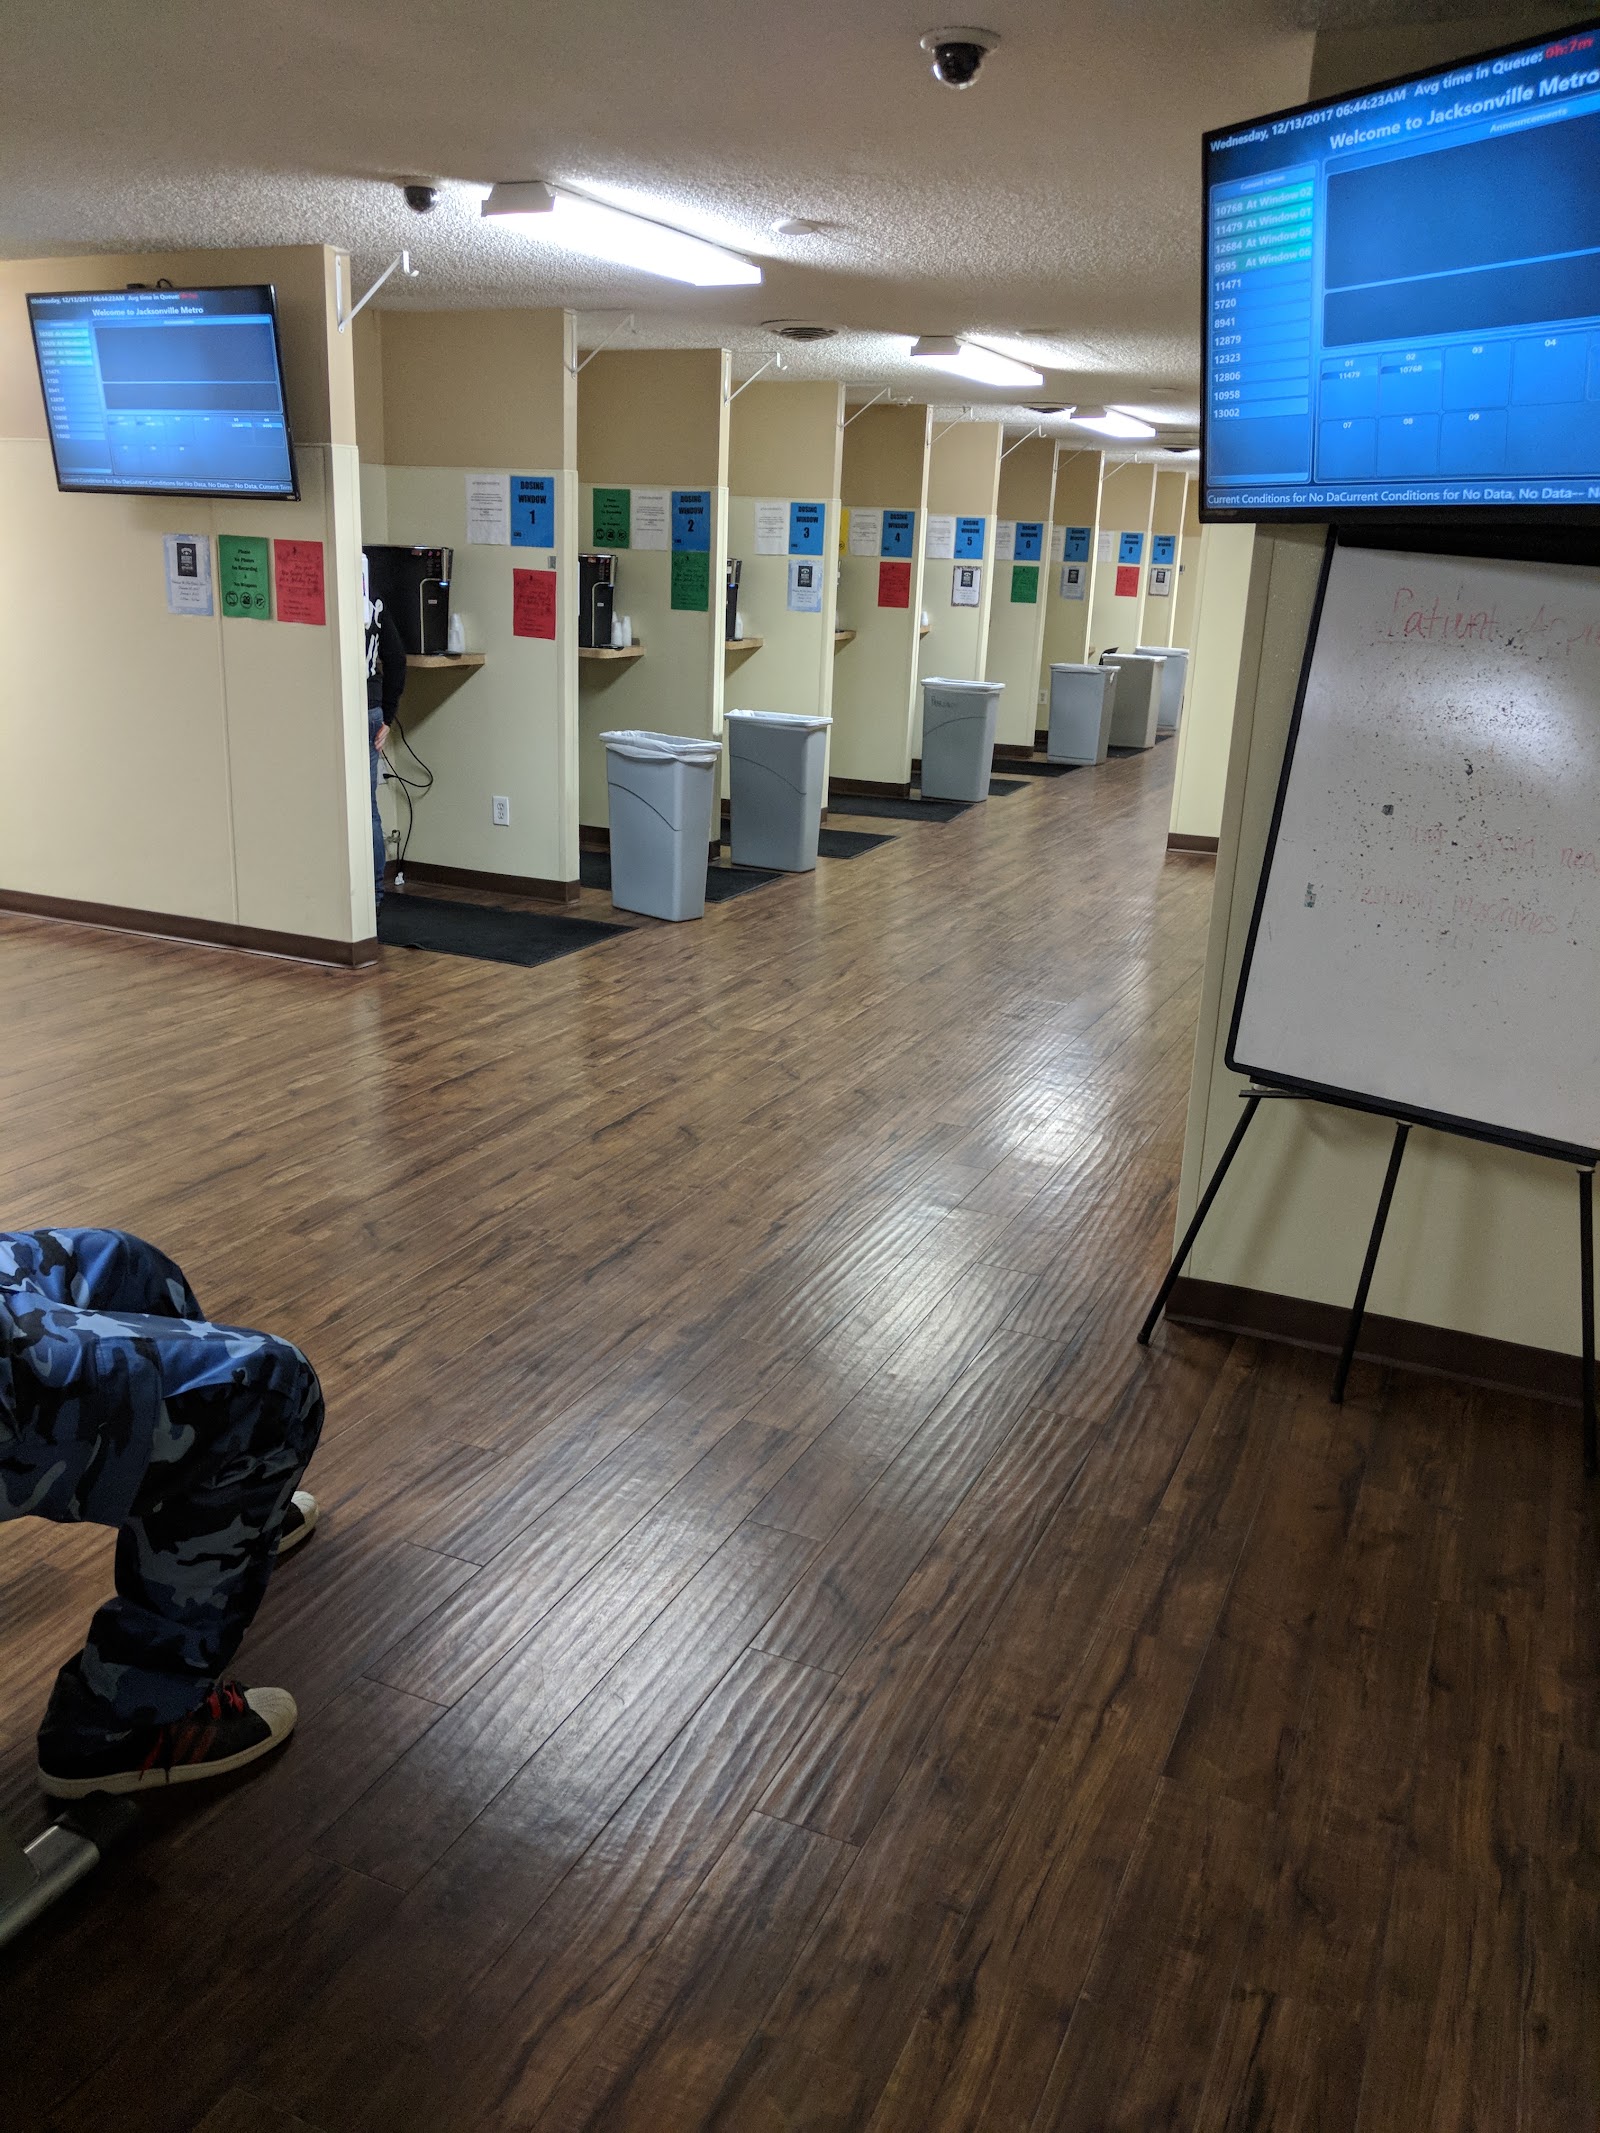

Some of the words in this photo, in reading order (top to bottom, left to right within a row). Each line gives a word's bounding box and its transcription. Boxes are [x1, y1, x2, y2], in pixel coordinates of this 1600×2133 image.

[1210, 129, 1269, 152] Wednesday,
[1272, 110, 1334, 136] 12/13/2017
[1414, 82, 1439, 97] Avg
[1443, 73, 1472, 89] time
[1476, 66, 1489, 80] in
[1492, 51, 1544, 76] Queue:
[1330, 123, 1400, 150] Welcome
[1405, 116, 1422, 131] to
[1427, 86, 1534, 126] Jacksonville
[1538, 69, 1600, 98] Metro
[1215, 201, 1243, 217] 10768
[1246, 198, 1257, 210] At
[1260, 191, 1299, 207] Window
[1215, 222, 1243, 236] 11479
[1246, 218, 1256, 230] At
[1259, 211, 1299, 227] Window
[1215, 240, 1242, 254] 12684
[1245, 237, 1256, 248] At
[1259, 230, 1298, 246] Window
[1214, 260, 1237, 274] 9595
[1245, 257, 1256, 269] At
[1258, 249, 1298, 265] Window
[1215, 279, 1241, 292] 11471
[1214, 298, 1237, 310] 5720
[92, 308, 125, 317] Welcome
[136, 306, 179, 315] Jacksonville
[180, 306, 204, 314] Metro
[1214, 317, 1235, 329] 8941
[1214, 335, 1241, 347] 12879
[1214, 353, 1241, 365] 12323
[1214, 371, 1241, 383] 12806
[1214, 390, 1240, 401] 10958
[1213, 408, 1240, 419] 13002
[520, 480, 544, 490] DOSING
[518, 494, 547, 504] WINDOW
[680, 495, 702, 503] DOSING
[1208, 495, 1240, 504] Current
[1242, 494, 1290, 504] Conditions
[1292, 493, 1306, 503] for
[1309, 493, 1323, 503] No
[1381, 490, 1440, 502] Conditions
[1443, 489, 1459, 501] for
[1462, 489, 1481, 500] No
[1484, 488, 1515, 501] Data,
[1519, 488, 1537, 499] No
[529, 509, 535, 524] 1
[687, 519, 694, 532] 2
[803, 527, 810, 538] 3
[894, 532, 901, 543] 4
[966, 536, 973, 546] 5
[1025, 540, 1031, 549] 6
